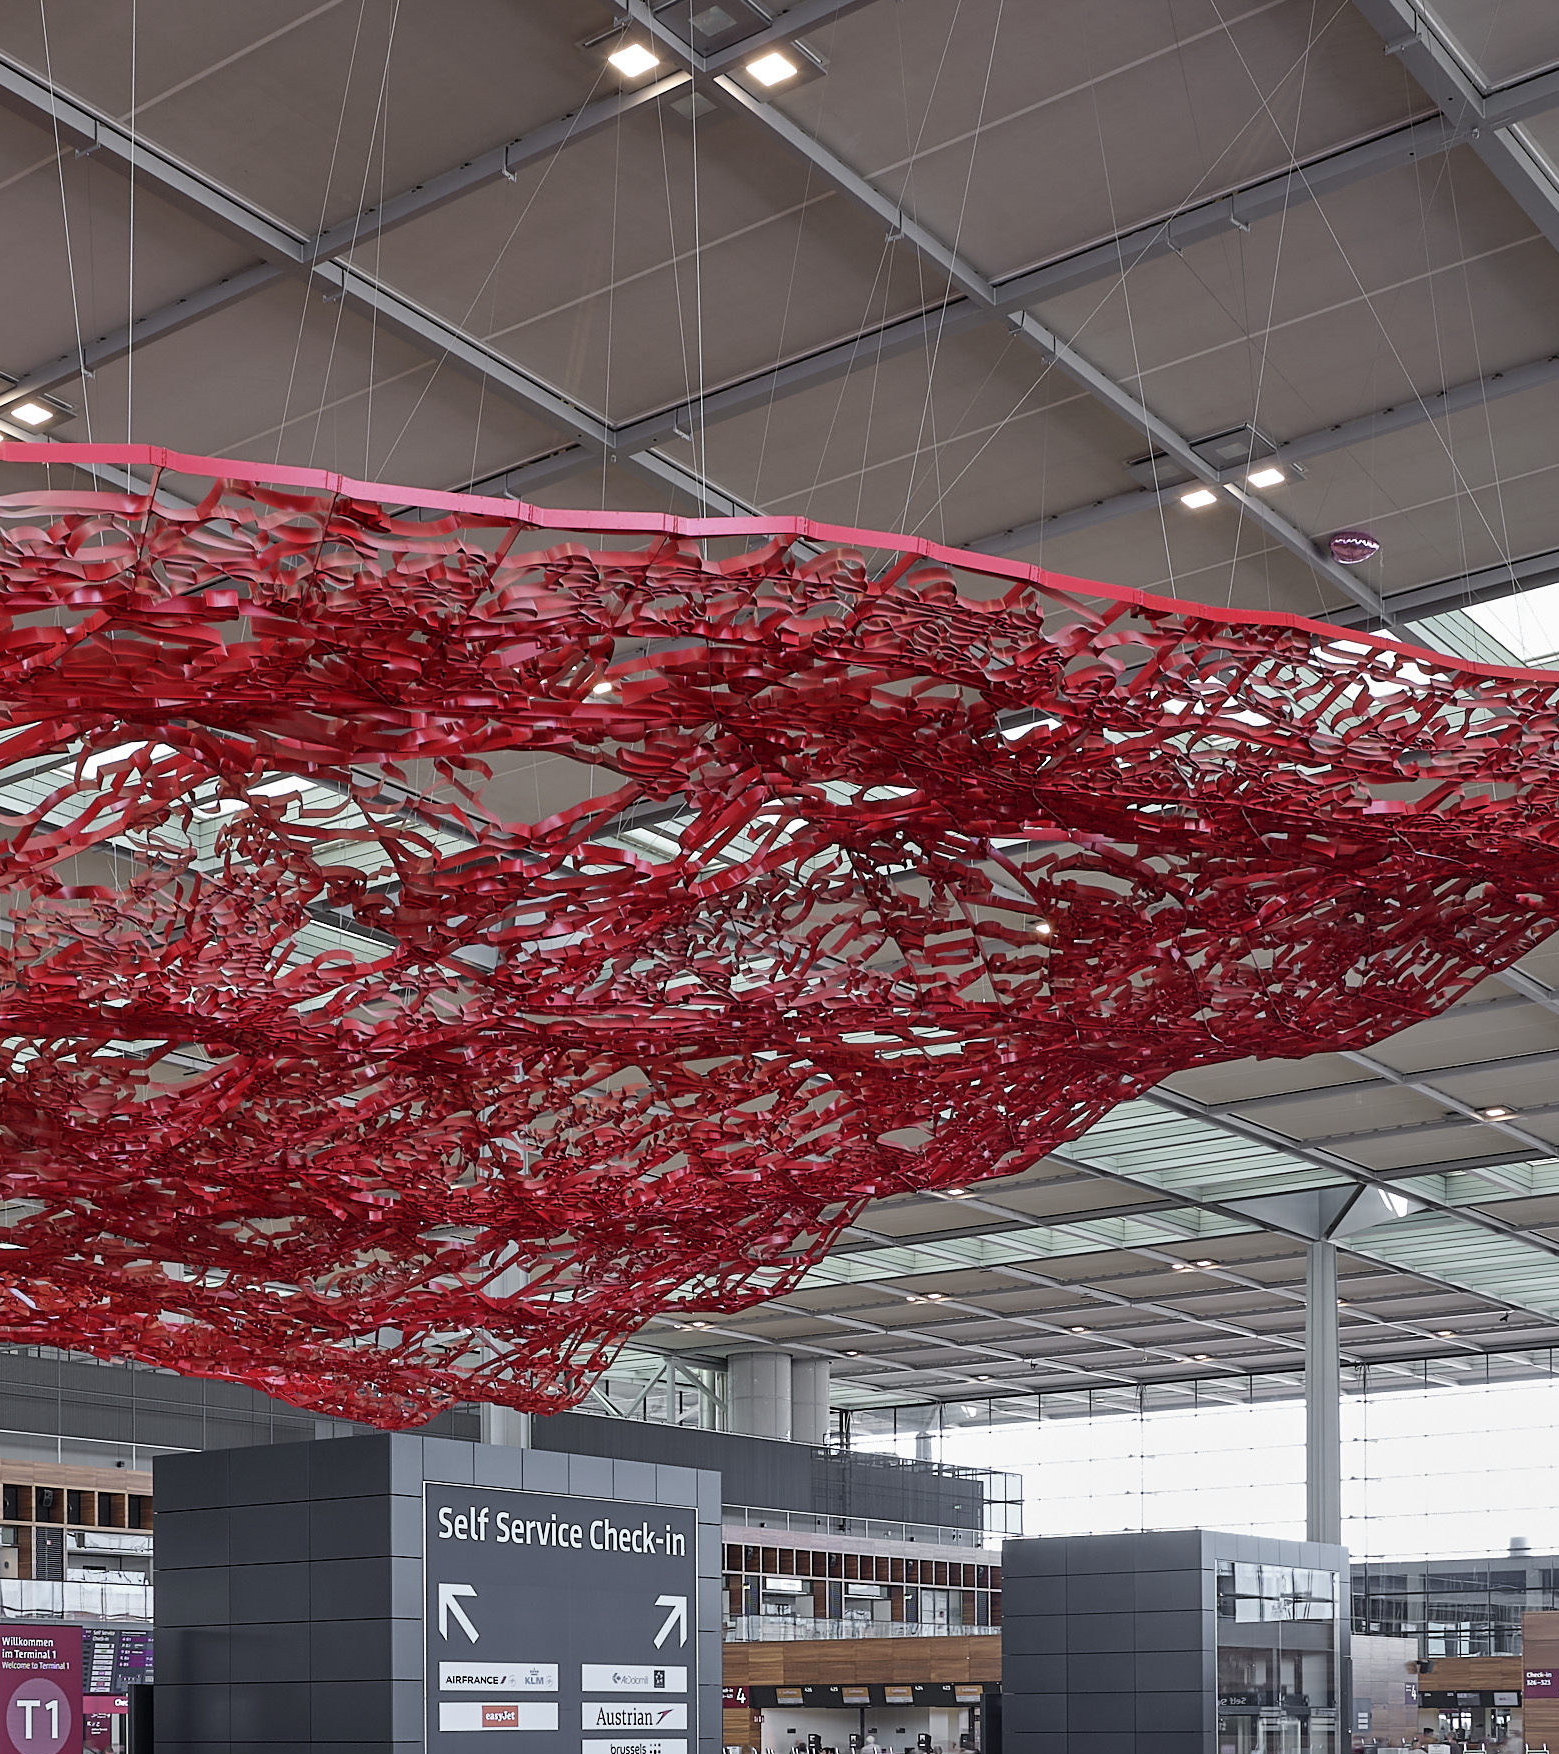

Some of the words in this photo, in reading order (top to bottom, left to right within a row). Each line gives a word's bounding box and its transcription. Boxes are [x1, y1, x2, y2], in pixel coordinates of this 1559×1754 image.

[438, 1506, 490, 1541] Self
[496, 1511, 583, 1549] Service
[590, 1518, 686, 1557] Check-in
[1, 1637, 54, 1647] Willkommen
[2, 1649, 13, 1659] im
[14, 1649, 51, 1660] Terminal
[52, 1650, 57, 1659] 1
[1, 1661, 30, 1669] Welcome
[31, 1661, 38, 1669] to
[39, 1662, 66, 1670] Terminal
[446, 1675, 499, 1685] AIRFRANCE
[524, 1677, 544, 1685] KLM
[736, 1687, 747, 1704] 4
[16, 1699, 59, 1740] T1
[485, 1711, 516, 1722] easyJet
[596, 1706, 653, 1726] Austrian
[610, 1743, 647, 1754] brussels
